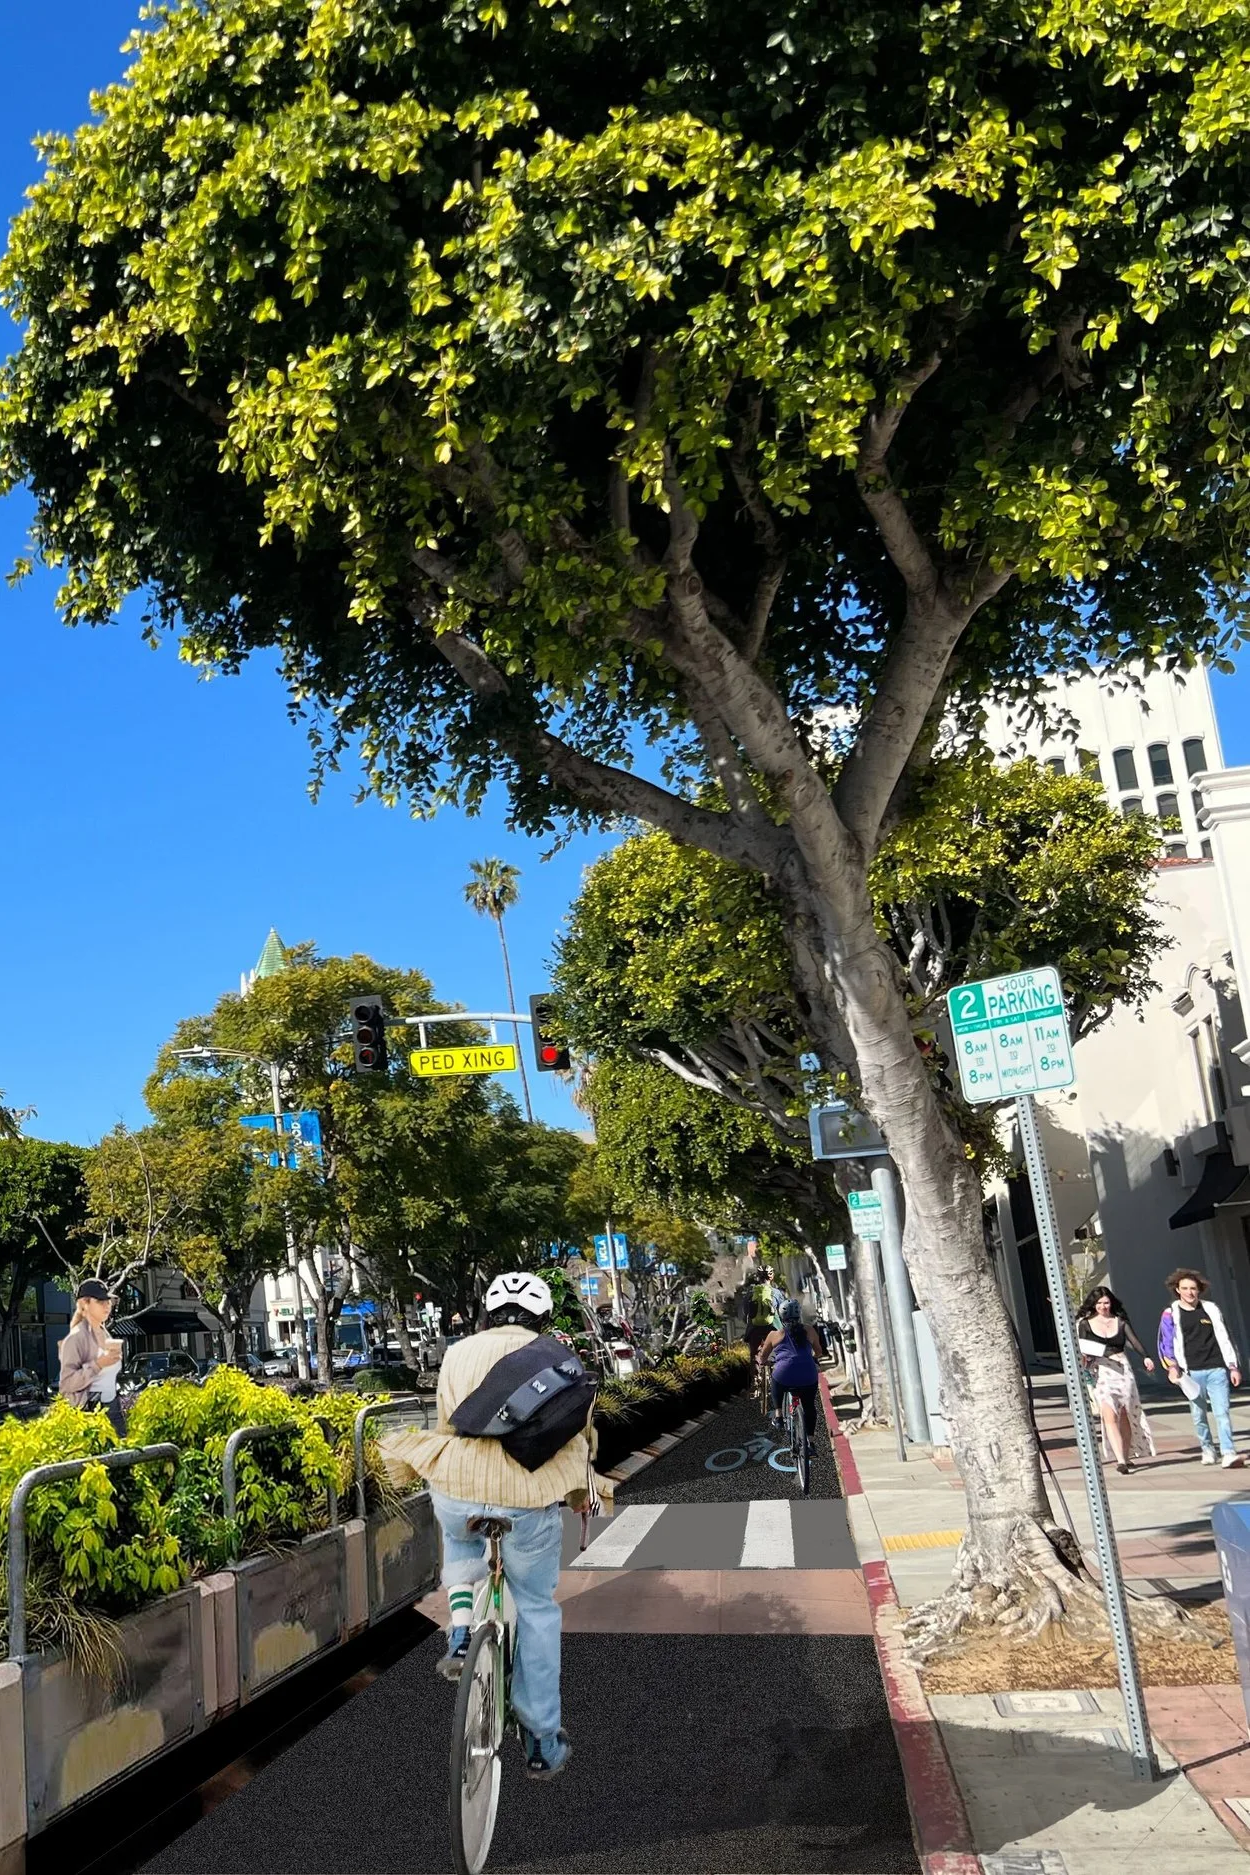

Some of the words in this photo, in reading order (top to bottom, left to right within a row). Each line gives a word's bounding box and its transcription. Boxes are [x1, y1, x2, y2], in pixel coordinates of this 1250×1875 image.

[958, 990, 979, 1020] 2
[987, 984, 1055, 1018] PARKING
[419, 1054, 455, 1071] PED
[462, 1051, 505, 1069] XING
[1001, 1064, 1033, 1078] MIDNIGHT
[598, 1240, 609, 1262] UCLA
